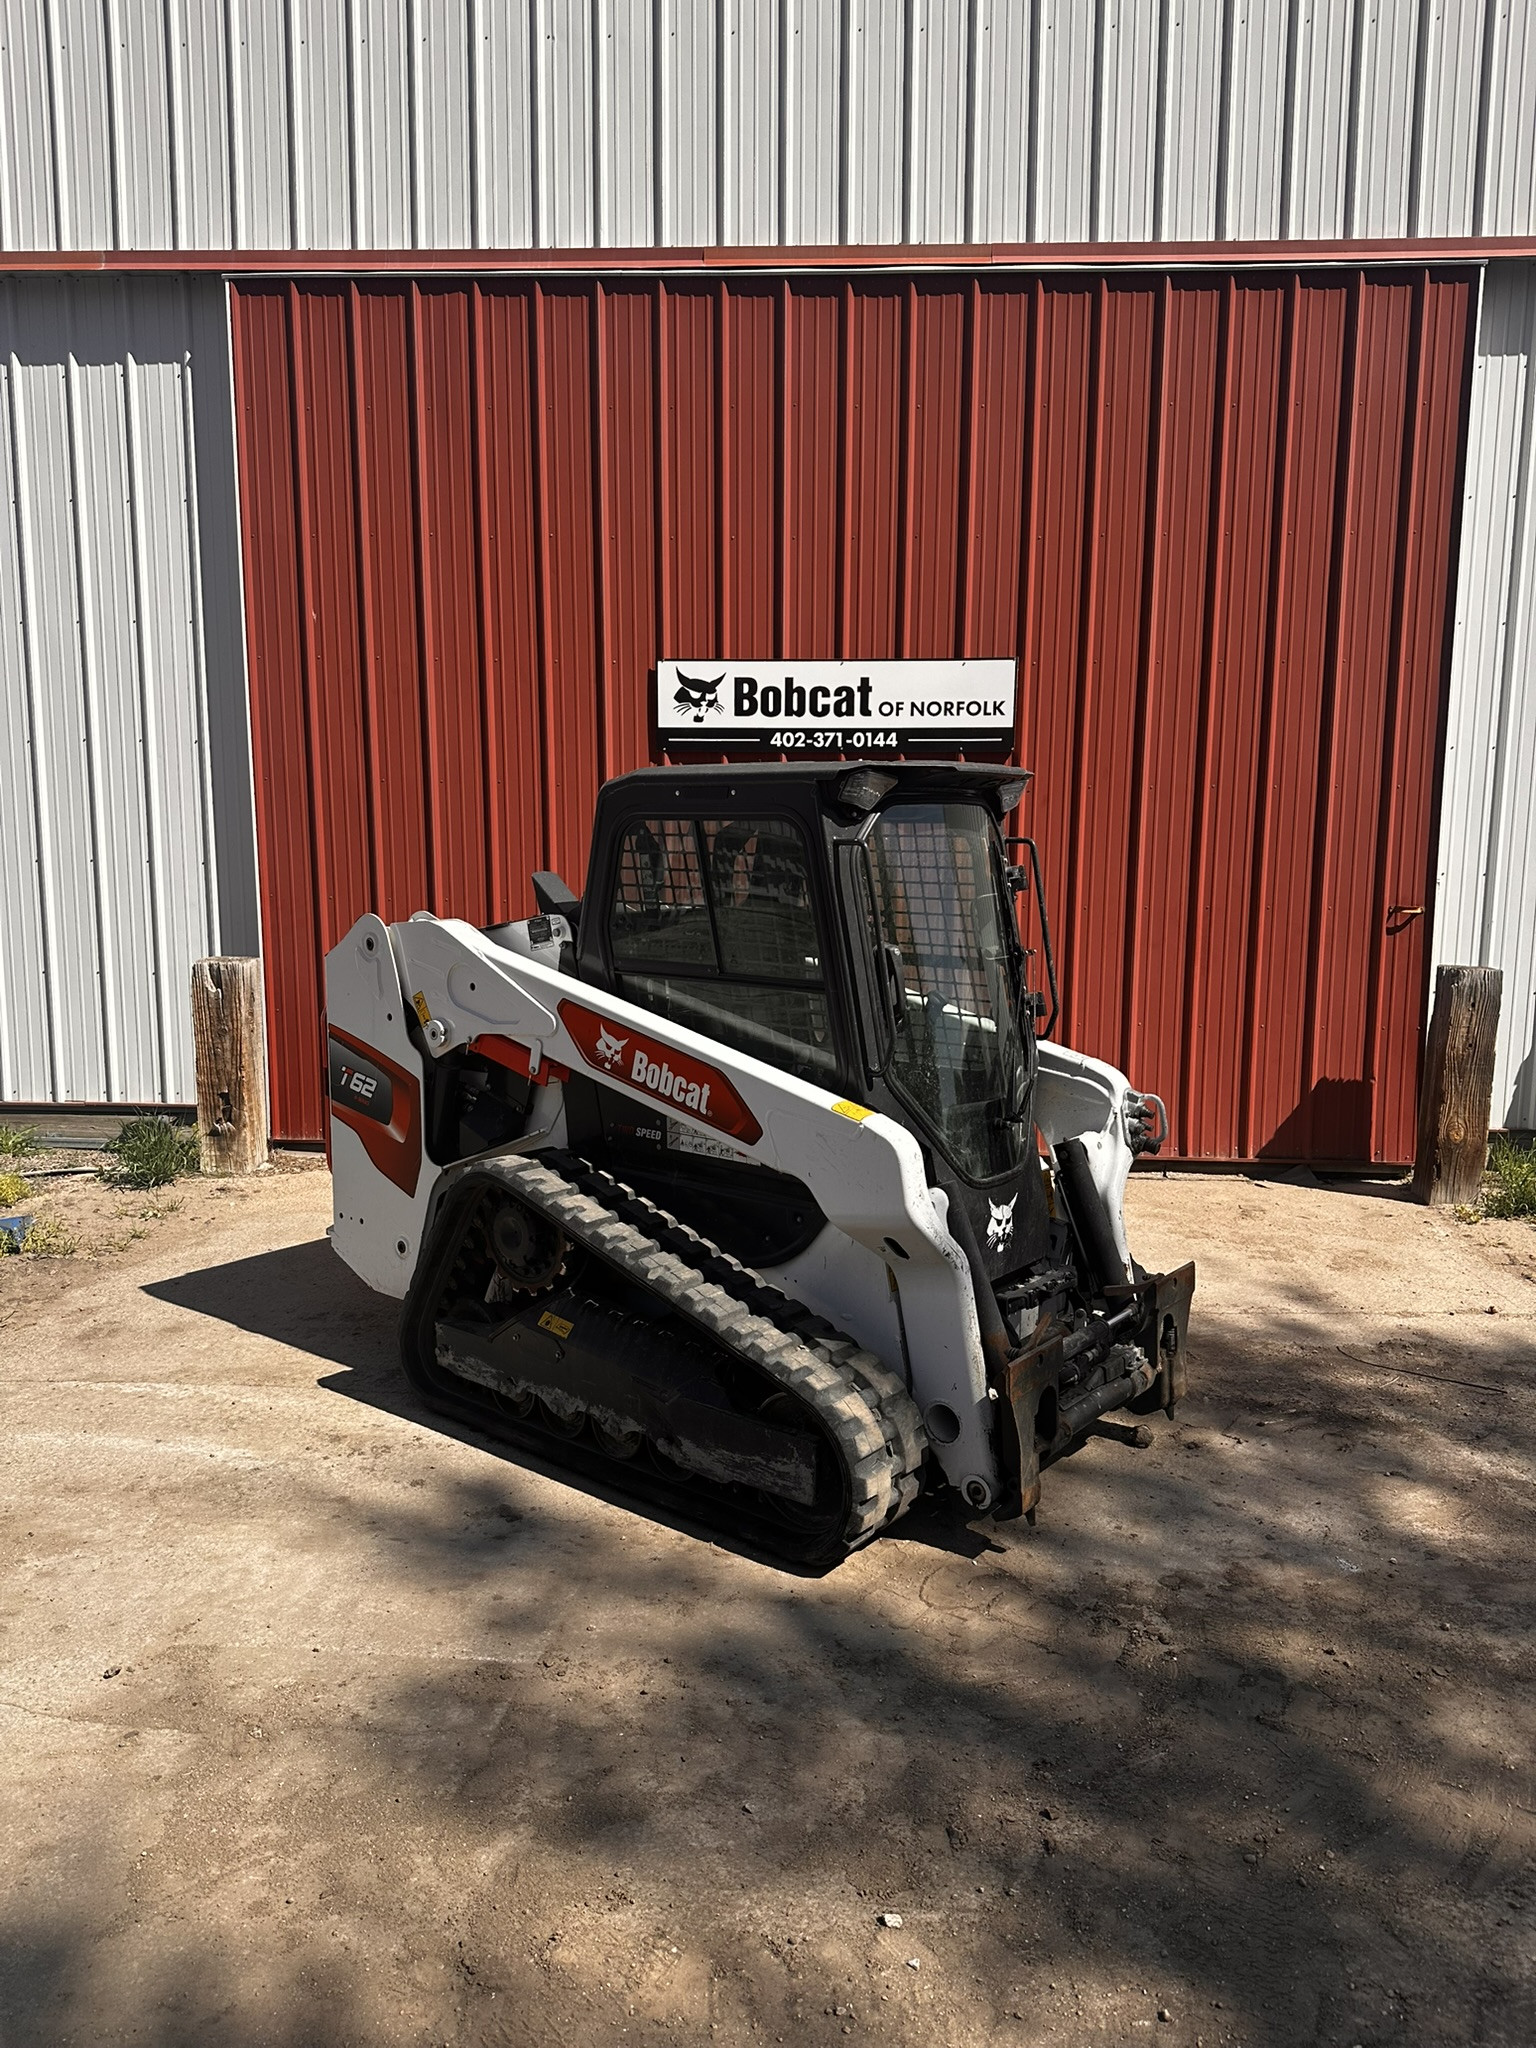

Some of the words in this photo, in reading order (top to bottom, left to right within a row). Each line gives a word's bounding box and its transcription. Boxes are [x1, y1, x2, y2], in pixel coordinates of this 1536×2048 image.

[734, 677, 872, 717] Bobcat
[878, 701, 904, 716] OF
[910, 701, 1005, 716] NORFOLK
[770, 732, 898, 747] 402-371-0144
[340, 1066, 378, 1098] T62
[631, 1049, 710, 1115] Bobcat
[635, 1127, 662, 1141] SPEED
